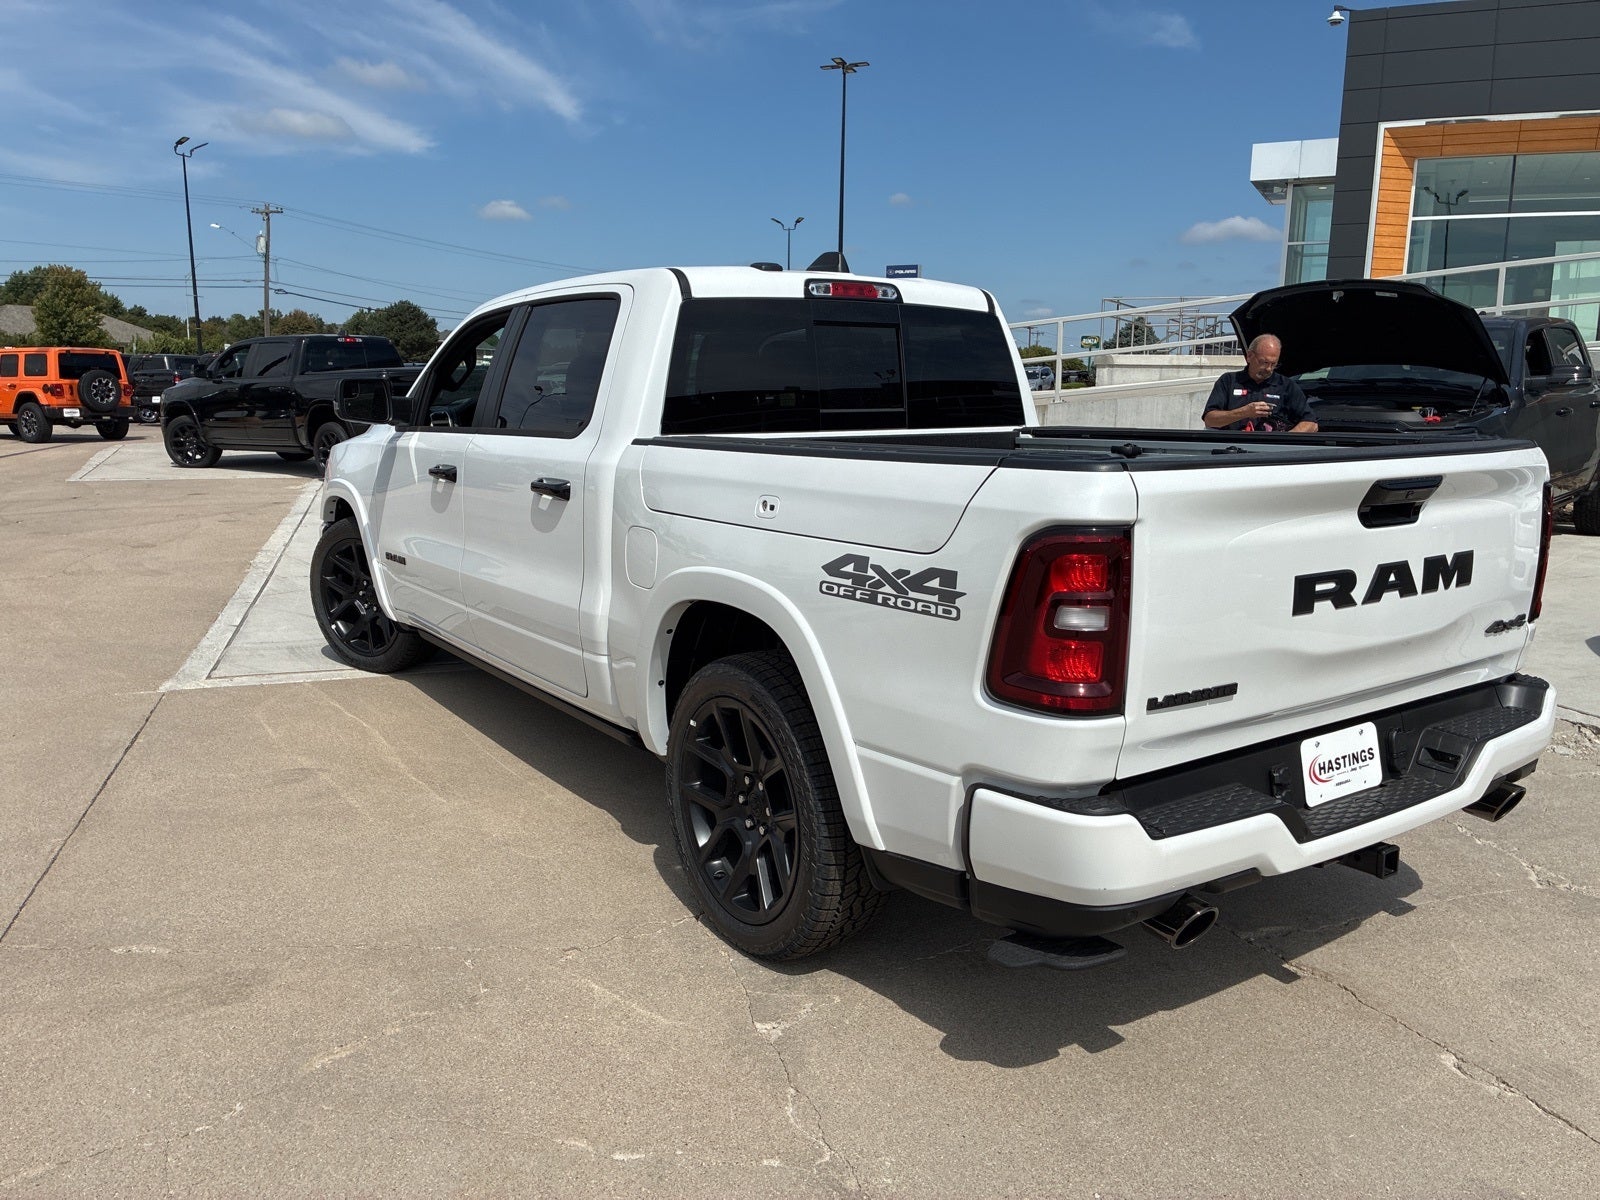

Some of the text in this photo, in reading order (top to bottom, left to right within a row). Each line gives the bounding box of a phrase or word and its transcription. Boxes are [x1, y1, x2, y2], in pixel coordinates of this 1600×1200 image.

[821, 581, 957, 618] OFF ROAD
[1292, 550, 1474, 616] RAM
[1318, 747, 1375, 776] HASTINGS
